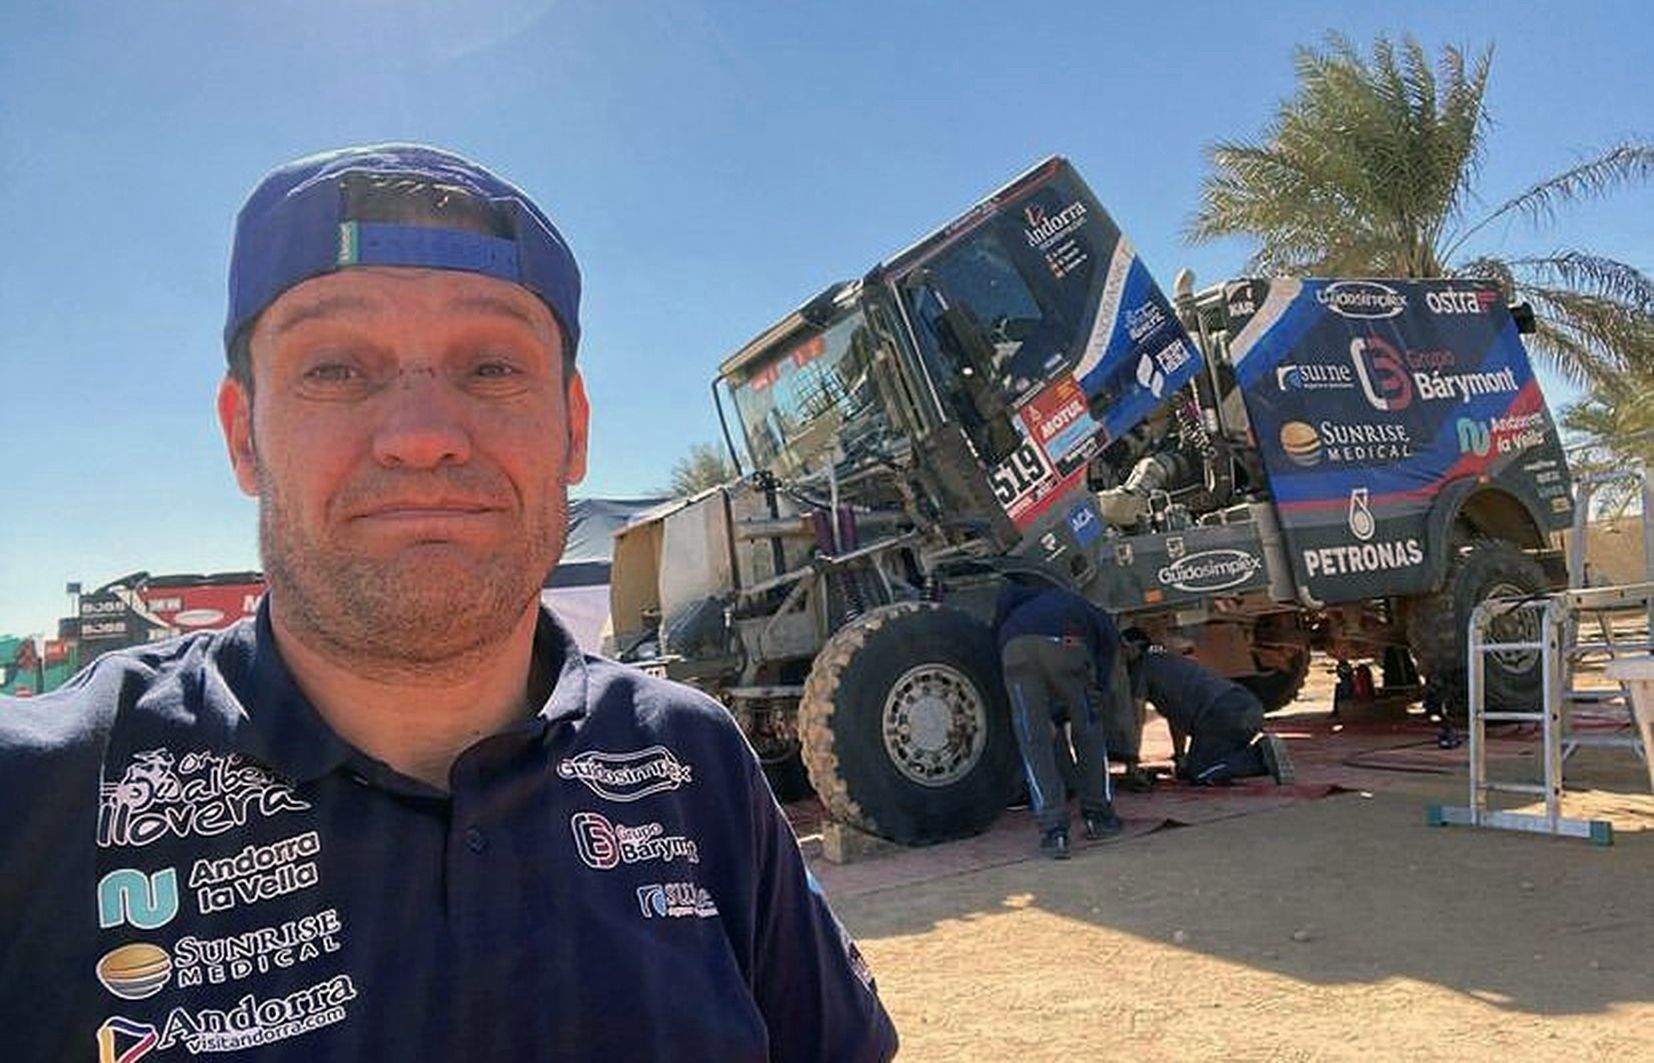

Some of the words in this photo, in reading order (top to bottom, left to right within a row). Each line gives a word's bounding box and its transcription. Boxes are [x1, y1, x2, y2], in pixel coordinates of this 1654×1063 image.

[1413, 365, 1520, 404] Bárymont
[988, 443, 1047, 506] 519
[1327, 445, 1415, 462] MEDICAL
[1303, 538, 1424, 578] PETRONAS
[188, 831, 321, 888] Andorra
[197, 887, 236, 915] la
[236, 862, 319, 905] Vella
[177, 936, 341, 990] MEDICAL
[156, 974, 358, 1051] Andorra
[186, 1005, 348, 1056] visitandorra.com
